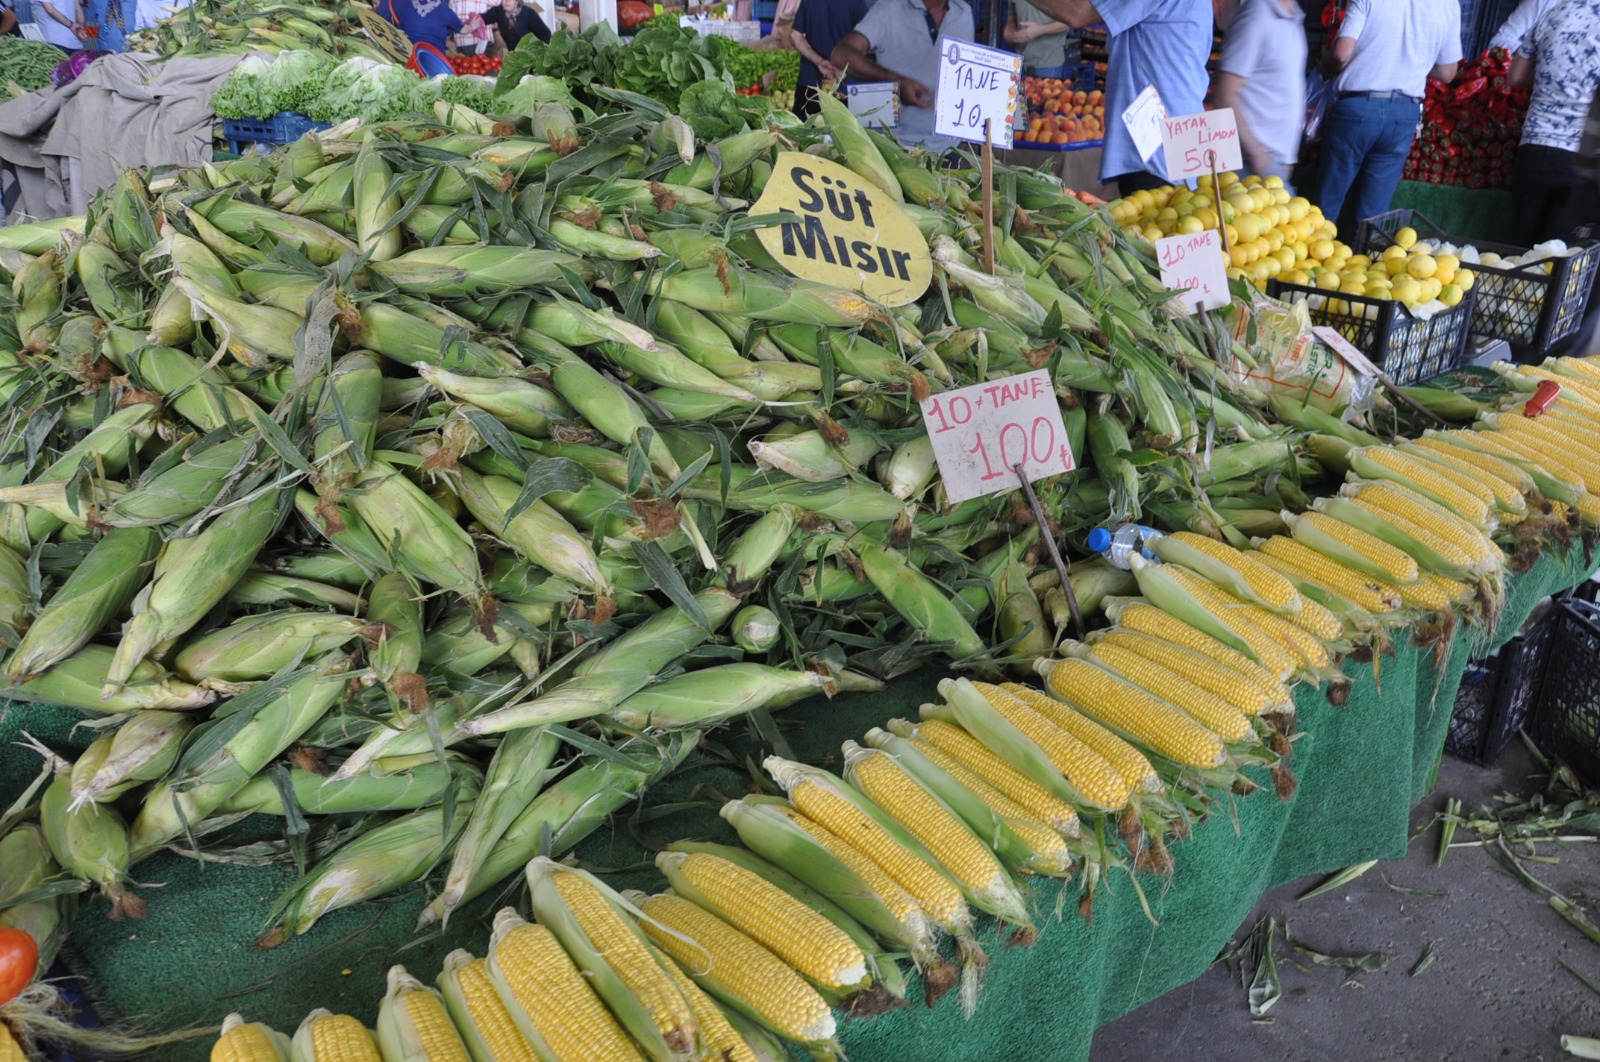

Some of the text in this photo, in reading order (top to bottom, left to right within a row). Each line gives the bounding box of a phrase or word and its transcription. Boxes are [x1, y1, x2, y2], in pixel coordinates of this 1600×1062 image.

[955, 64, 999, 91] TANE
[1165, 116, 1207, 140] YATAK
[790, 166, 875, 228] Süt
[1163, 232, 1212, 267] 10 TANE
